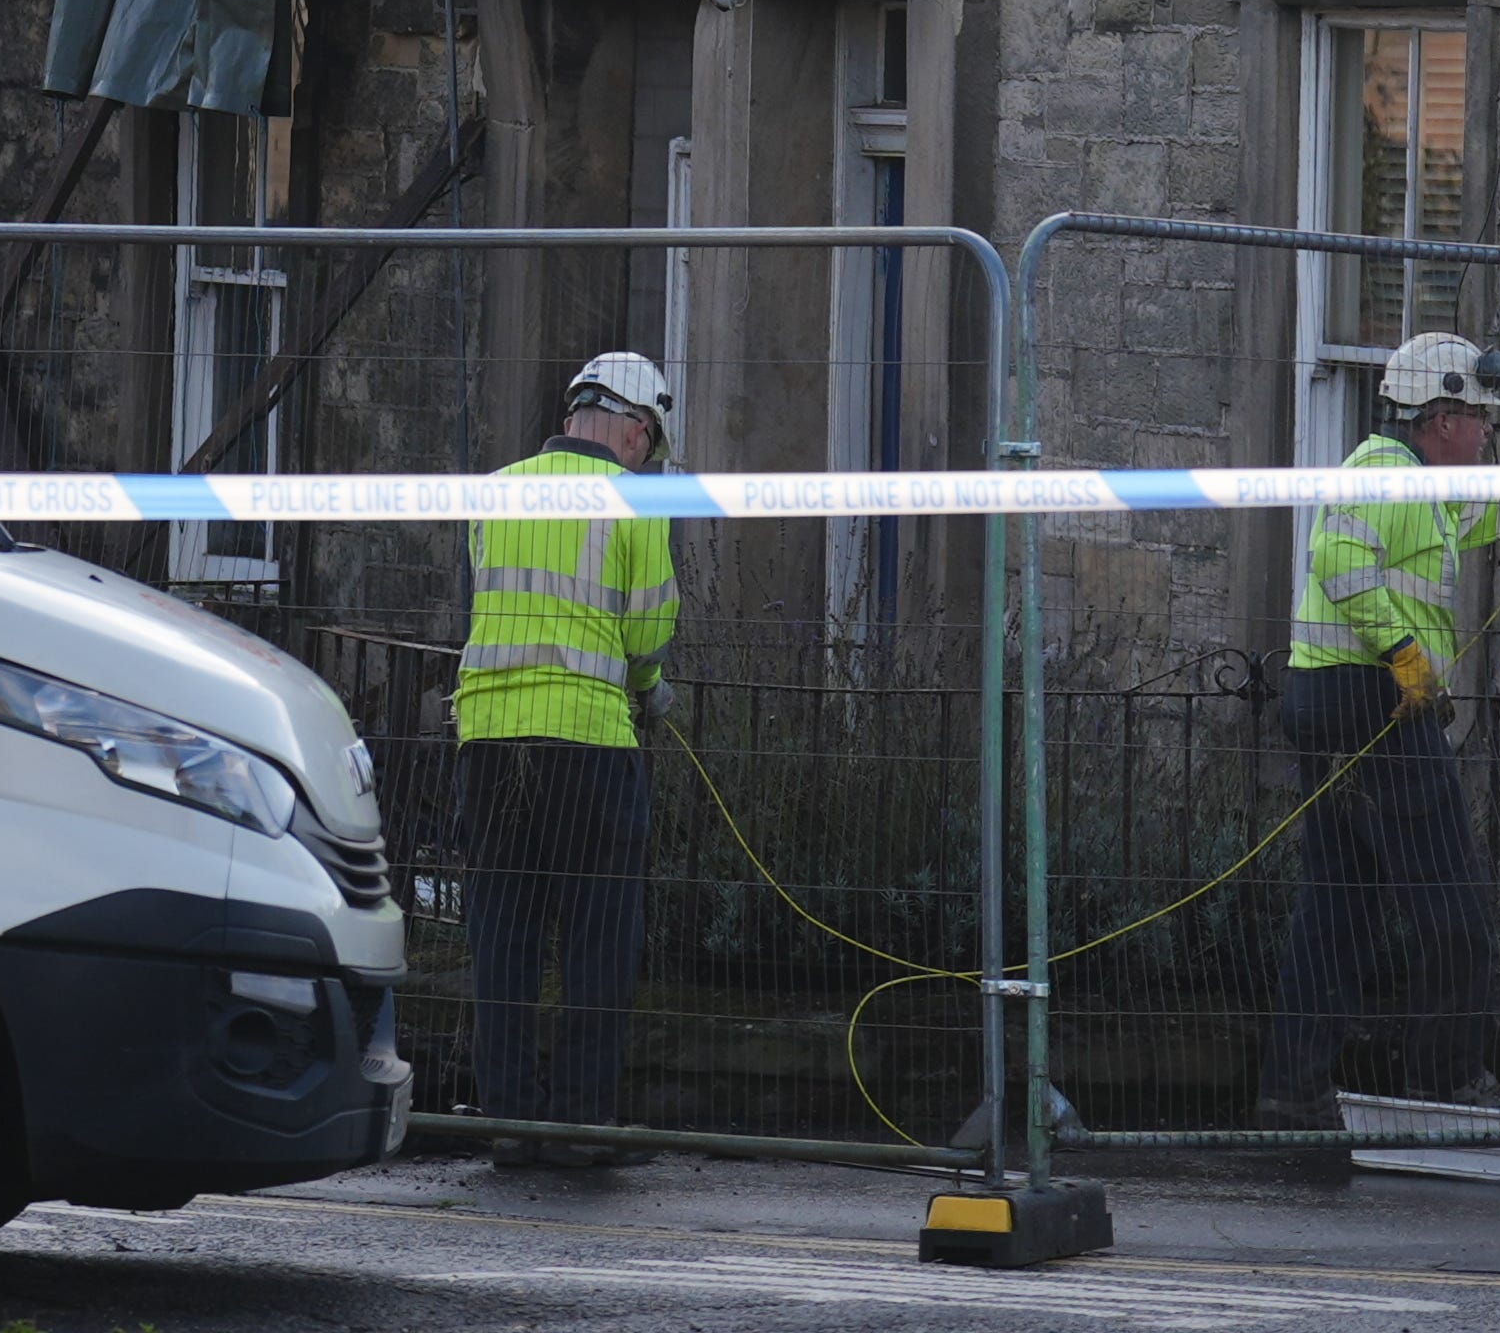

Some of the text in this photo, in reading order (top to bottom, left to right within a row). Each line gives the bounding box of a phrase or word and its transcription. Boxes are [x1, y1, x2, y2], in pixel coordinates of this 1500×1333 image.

[27, 477, 112, 511] CROSS
[251, 478, 606, 512] POLICE LINE DO NOT CROSS
[744, 478, 1100, 511] POLICE LINE DO NOT CROSS
